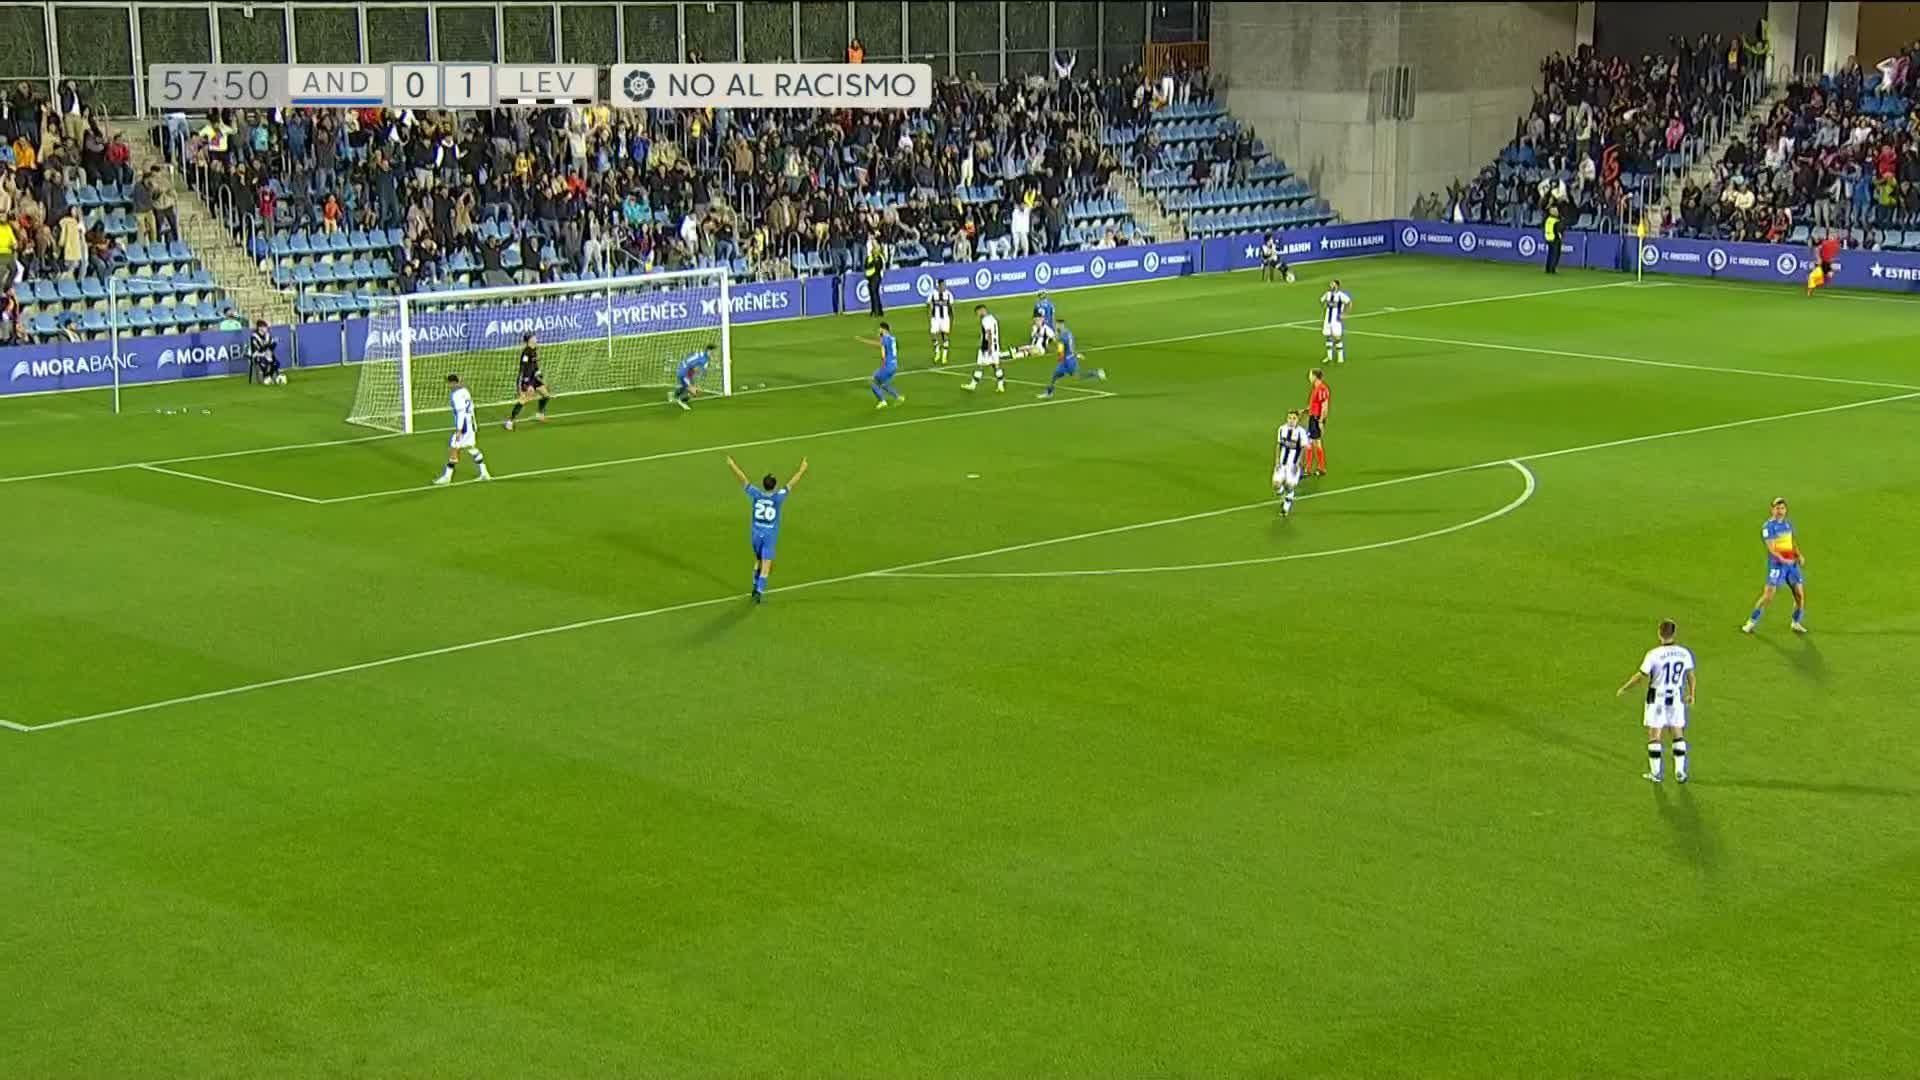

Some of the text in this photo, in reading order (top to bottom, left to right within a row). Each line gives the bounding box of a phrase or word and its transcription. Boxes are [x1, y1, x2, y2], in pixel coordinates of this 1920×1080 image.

[501, 312, 583, 335] MORABANC
[32, 353, 138, 377] MORABANC
[1663, 661, 1684, 685] 18
